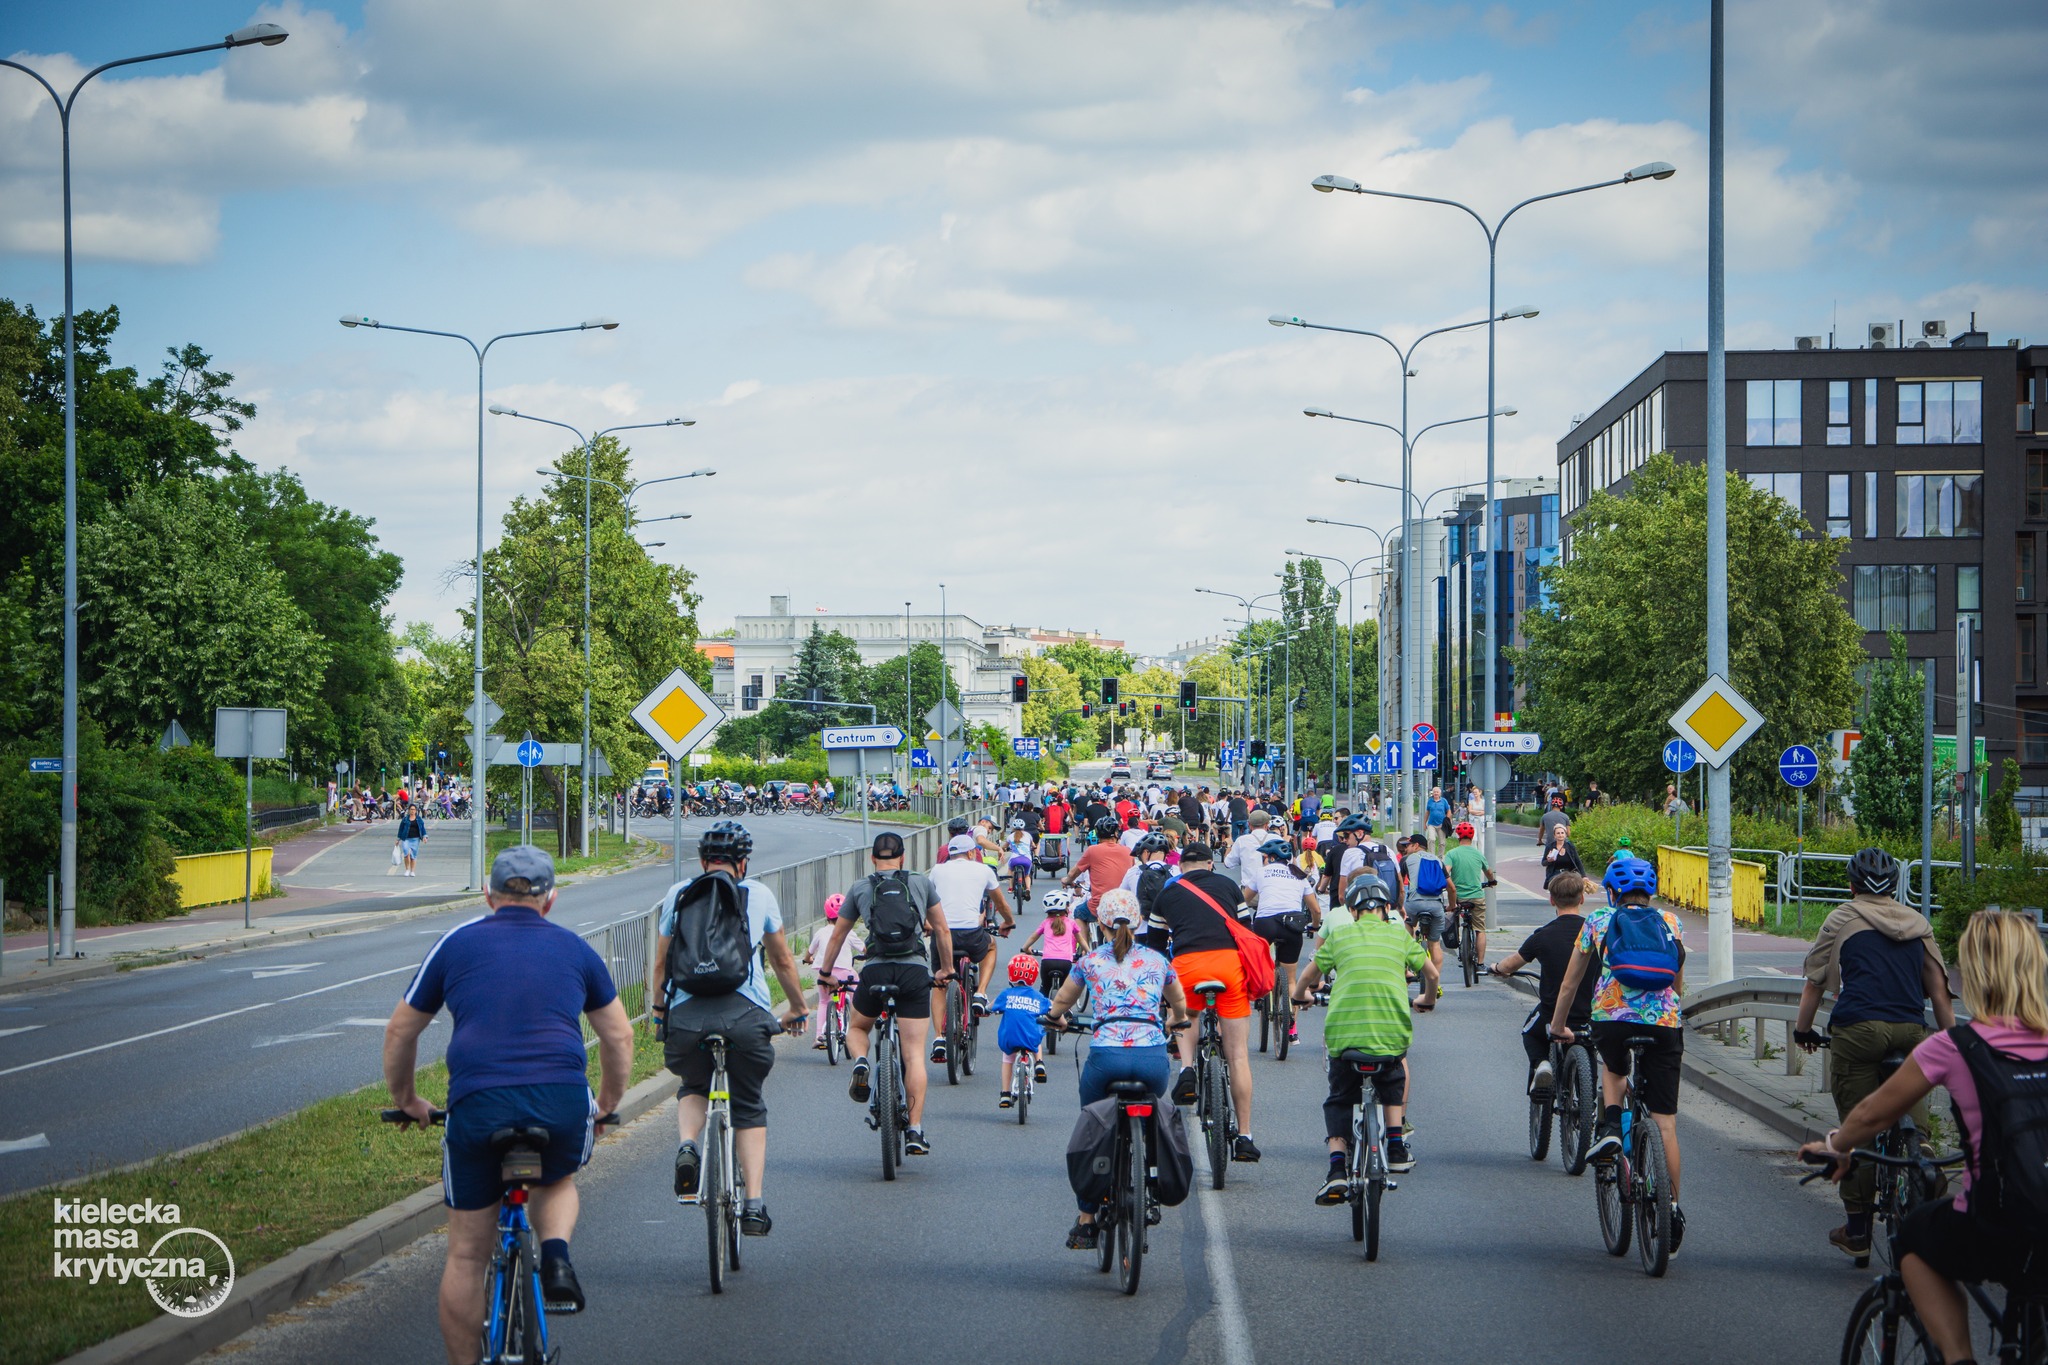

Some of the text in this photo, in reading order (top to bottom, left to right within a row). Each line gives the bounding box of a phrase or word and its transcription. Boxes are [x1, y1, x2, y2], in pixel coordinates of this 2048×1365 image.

[1494, 717, 1517, 728] mBank
[827, 733, 876, 744] Centrum
[1464, 736, 1515, 748] Centrum
[1015, 996, 1040, 1008] KIELCE
